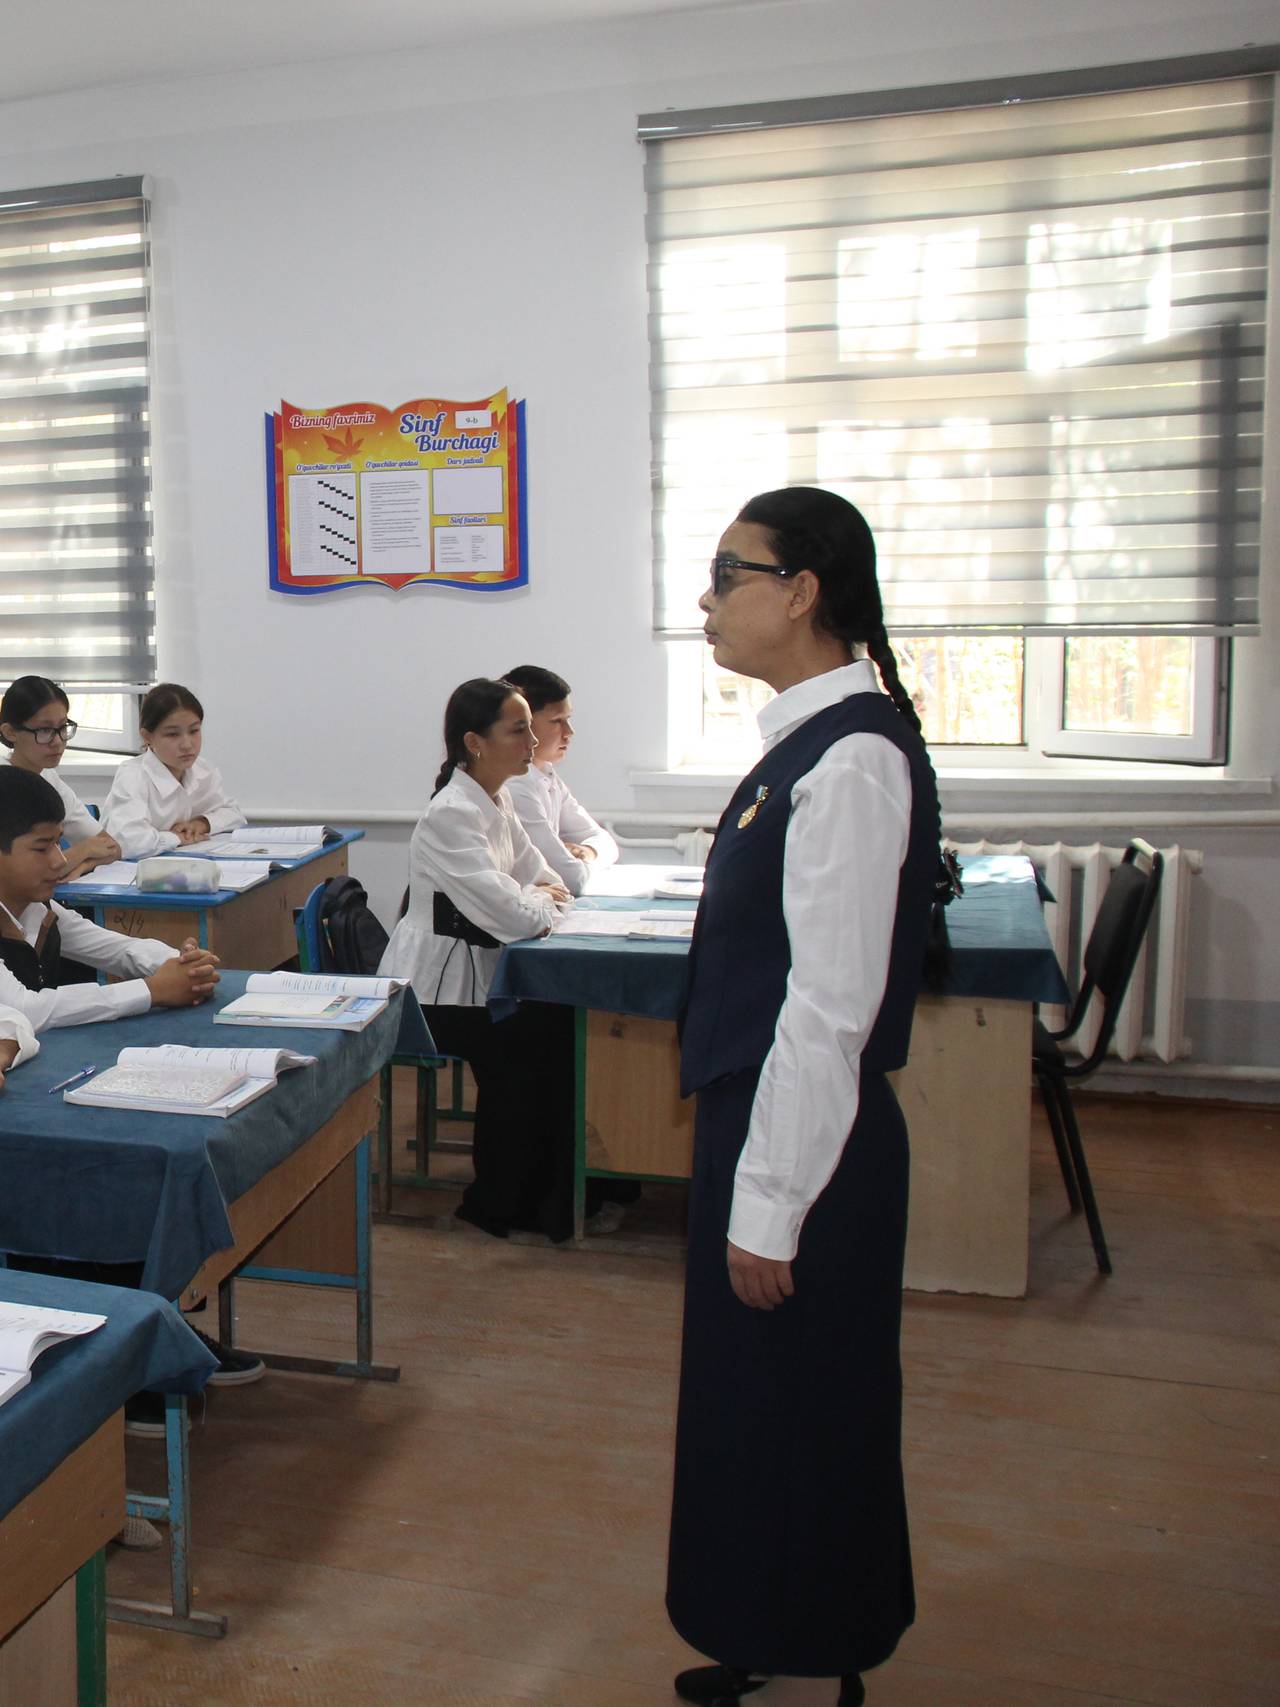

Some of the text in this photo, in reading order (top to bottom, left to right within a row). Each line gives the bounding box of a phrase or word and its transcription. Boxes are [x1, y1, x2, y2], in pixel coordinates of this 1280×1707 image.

[289, 412, 376, 430] Bizning faxrimiz
[399, 412, 446, 436] Sinf
[414, 431, 499, 453] Burchagi
